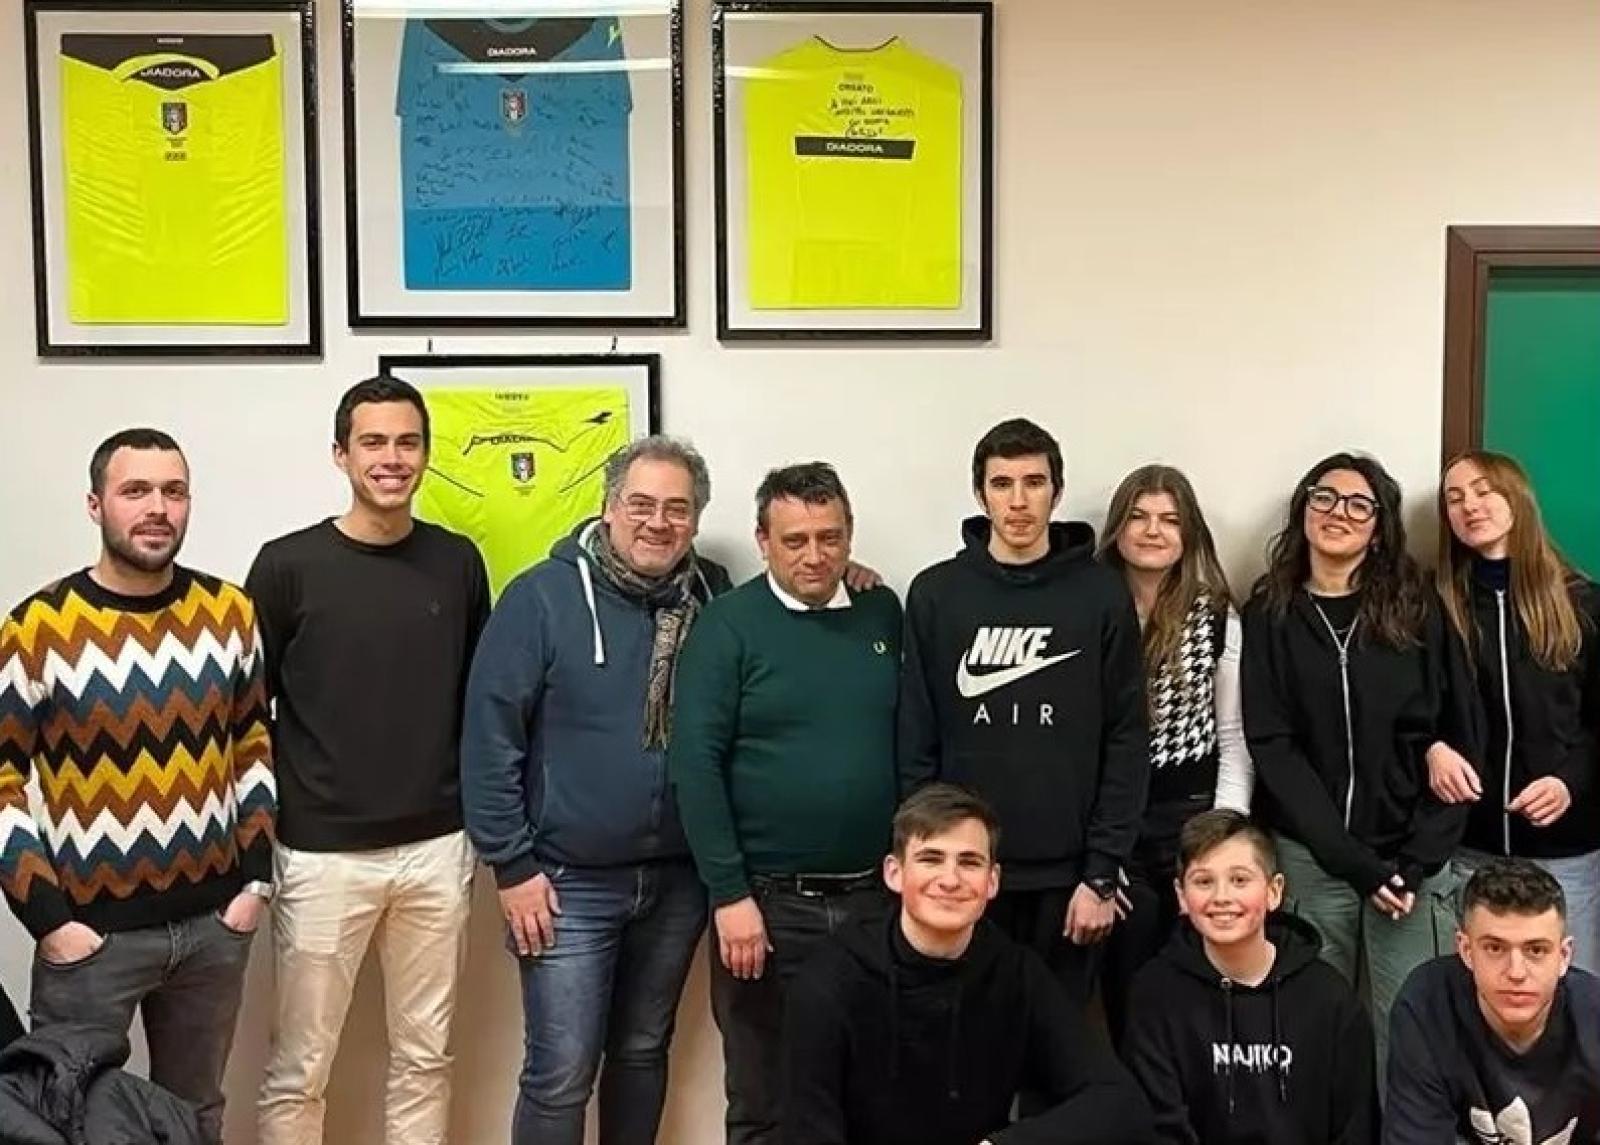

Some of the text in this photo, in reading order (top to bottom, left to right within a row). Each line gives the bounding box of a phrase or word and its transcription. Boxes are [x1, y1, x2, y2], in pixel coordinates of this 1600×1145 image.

[487, 47, 537, 57] DIADORA
[825, 142, 884, 153] DIADORA
[967, 626, 1054, 666] NIKE
[973, 702, 1054, 726] AIR
